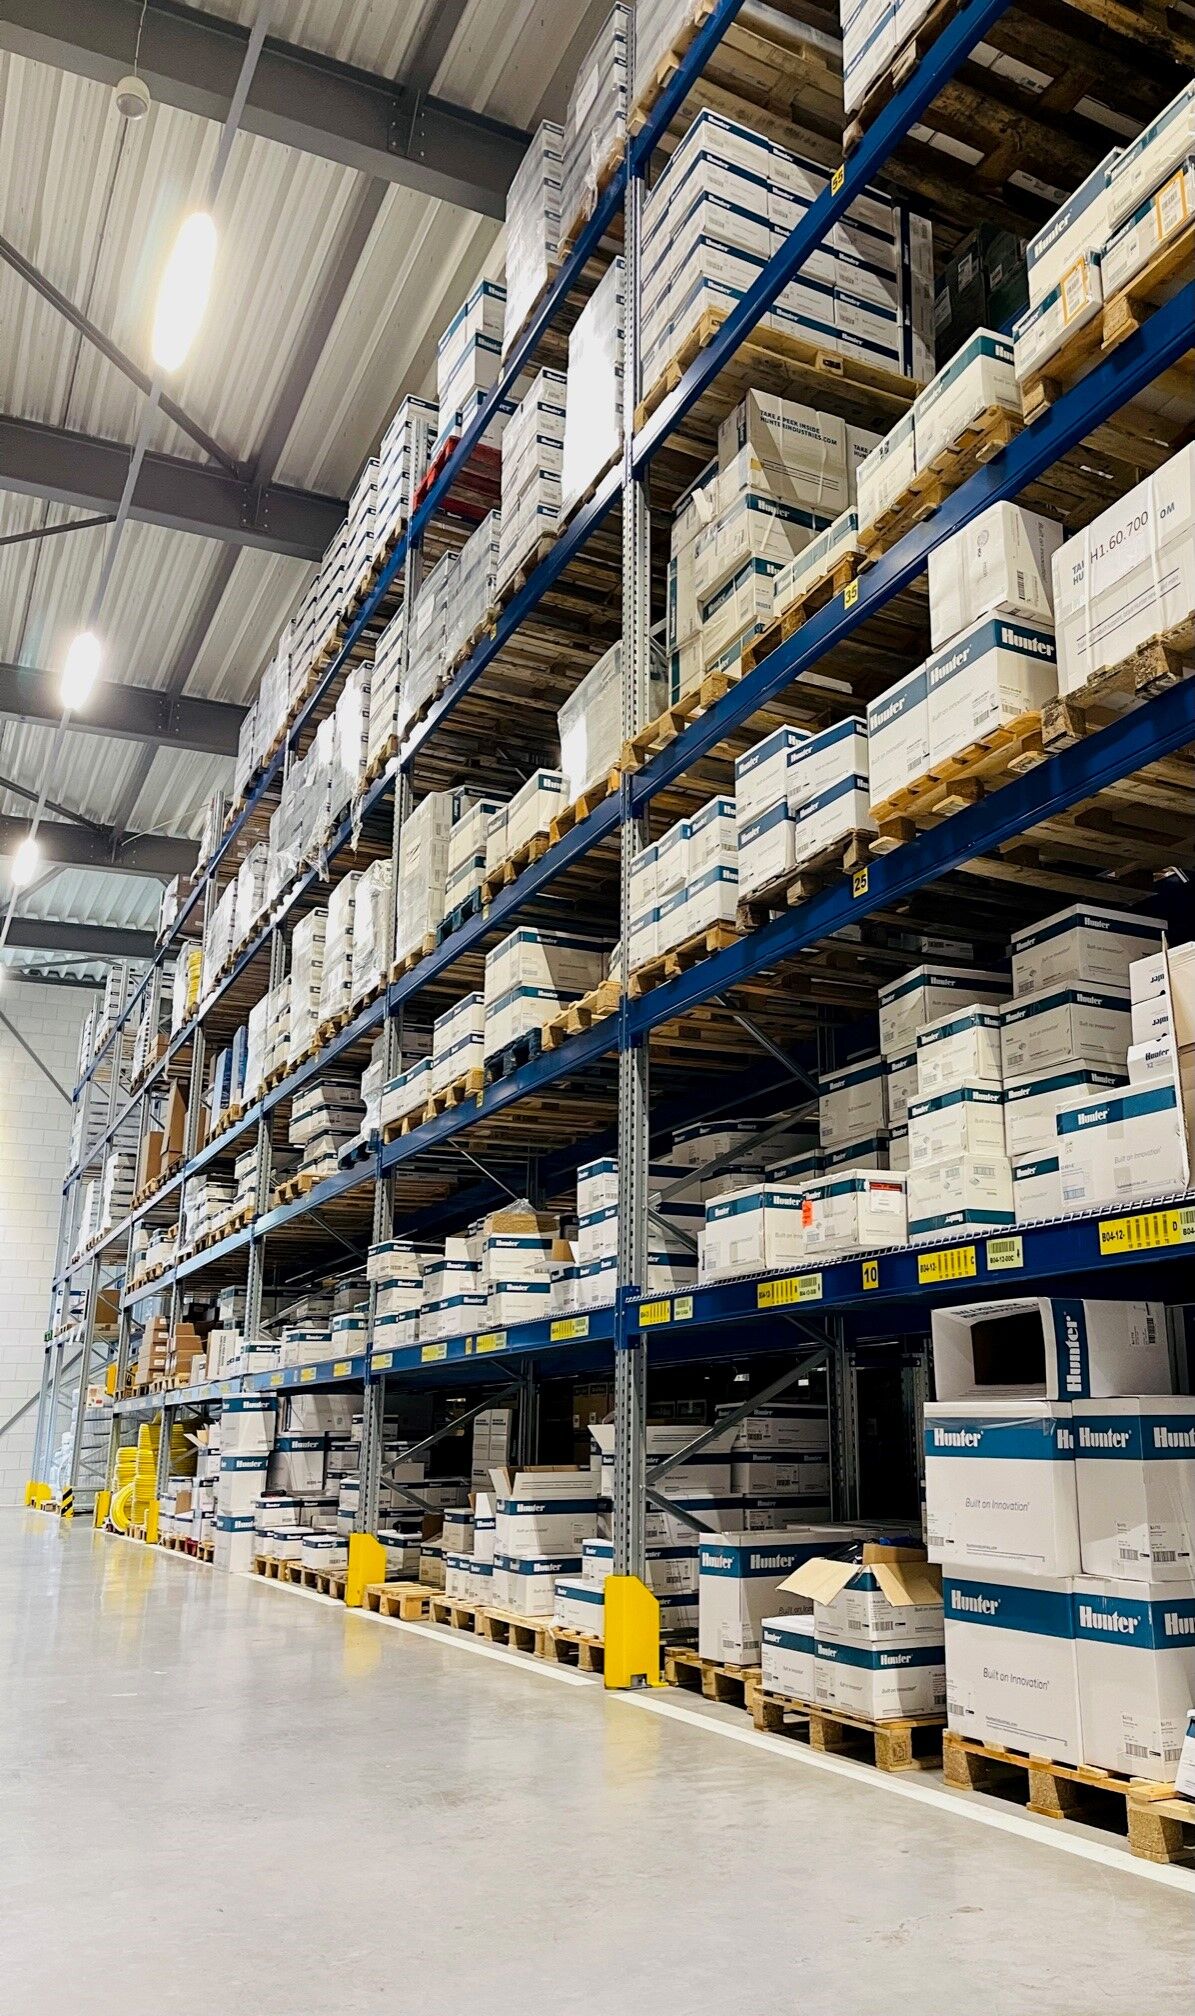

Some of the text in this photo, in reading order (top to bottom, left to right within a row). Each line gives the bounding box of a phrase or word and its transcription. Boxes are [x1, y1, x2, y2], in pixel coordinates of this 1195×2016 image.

[832, 171, 843, 190] 55
[1034, 214, 1070, 258] Hunter
[760, 410, 776, 420] TAKE
[800, 422, 820, 434] INSIDE
[1090, 511, 1149, 565] H1.60.700
[845, 585, 857, 603] 35
[1001, 627, 1054, 656] Hunter
[930, 648, 968, 686] Hunter
[870, 697, 904, 731] Hunter
[855, 875, 866, 890] 25
[1084, 917, 1110, 929] Hunter
[1016, 937, 1036, 951] Hunter
[930, 977, 956, 987] Hunter
[1076, 993, 1103, 1005] Hunter
[1145, 1049, 1170, 1061] Hunter
[1091, 1073, 1116, 1085] Hunter
[973, 1091, 999, 1101] Hunter
[1008, 1087, 1031, 1099] Hunter
[1078, 1110, 1108, 1125] Hunter
[1016, 1166, 1037, 1178] Hunter
[773, 1195, 802, 1206] Hunter
[1102, 1221, 1177, 1242] B04-12- D
[864, 1267, 877, 1283] 10
[1066, 1316, 1082, 1392] Hunter
[934, 1428, 981, 1448] Hunter
[1079, 1428, 1129, 1448] Hunter
[517, 1503, 545, 1513] Hunter
[965, 1497, 1028, 1512] Built on Innovation
[533, 1562, 562, 1573] Hunter
[702, 1553, 733, 1569] Hunter
[751, 1554, 795, 1570] Hunter
[951, 1589, 999, 1615] Hunter
[1079, 1605, 1139, 1634] Hunter
[817, 1645, 838, 1657] Hunter
[880, 1655, 912, 1665] Hunter
[983, 1667, 1047, 1690] Built on Innovation
